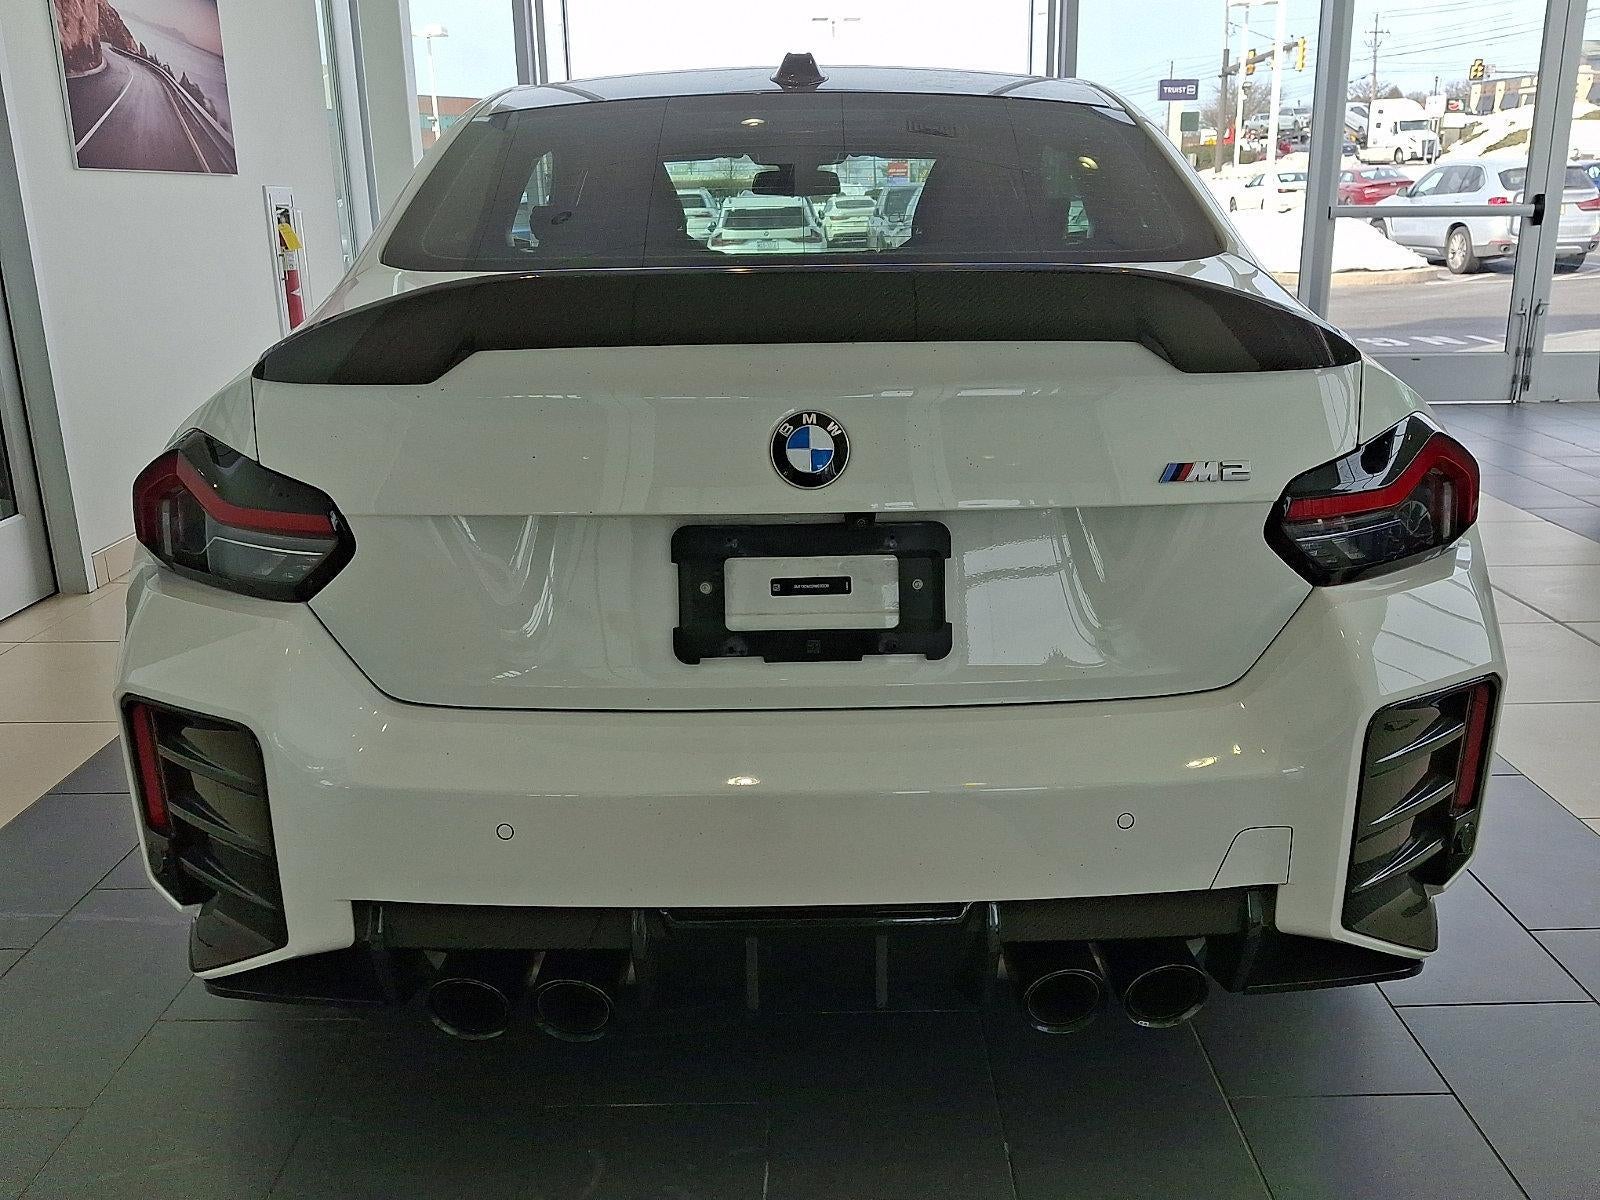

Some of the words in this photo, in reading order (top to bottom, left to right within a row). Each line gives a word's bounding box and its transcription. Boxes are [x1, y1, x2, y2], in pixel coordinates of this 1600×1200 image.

[1163, 86, 1187, 94] TRUIST
[779, 413, 842, 437] BMW
[1184, 460, 1251, 482] M2
